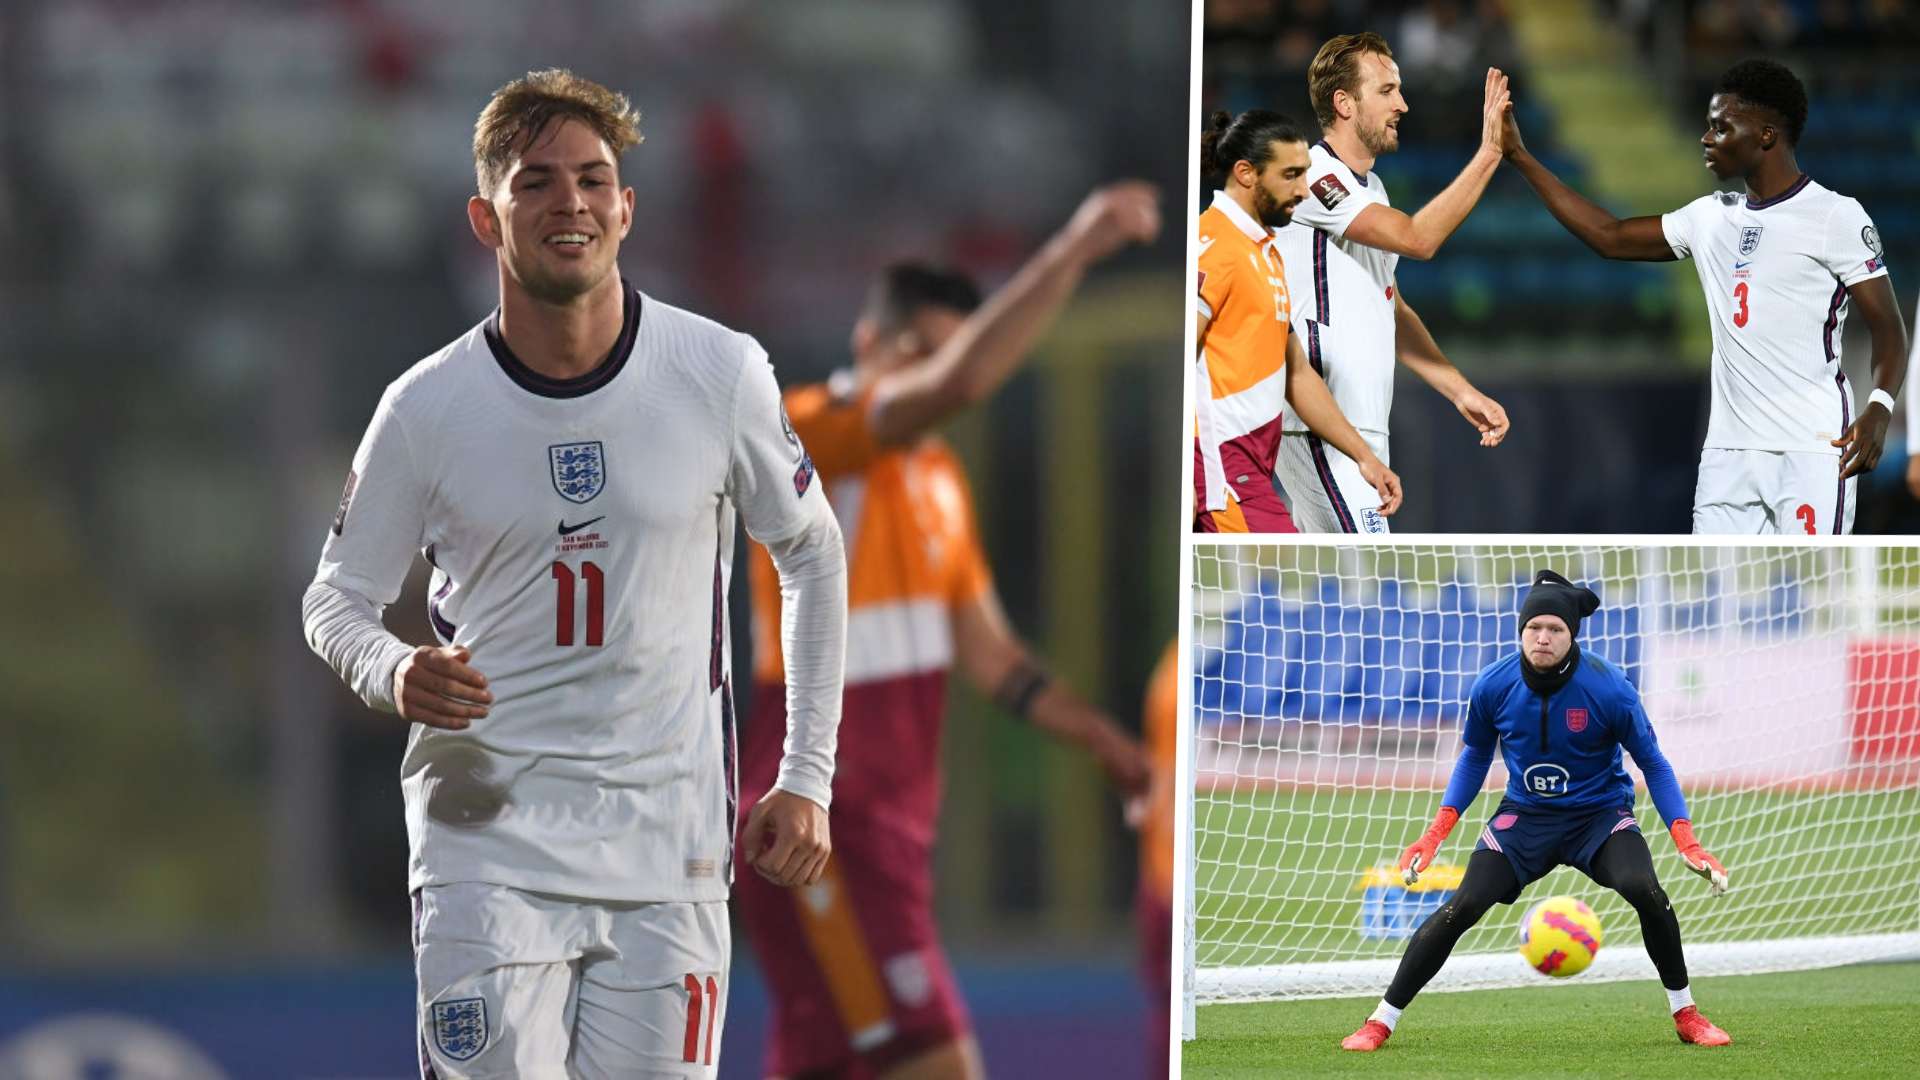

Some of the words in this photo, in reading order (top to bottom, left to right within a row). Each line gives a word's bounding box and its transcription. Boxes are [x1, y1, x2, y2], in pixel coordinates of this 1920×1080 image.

[1733, 281, 1749, 329] 3
[1796, 503, 1817, 535] 3
[552, 561, 605, 647] 11
[1533, 775, 1560, 791] BT
[683, 972, 719, 1066] 11
